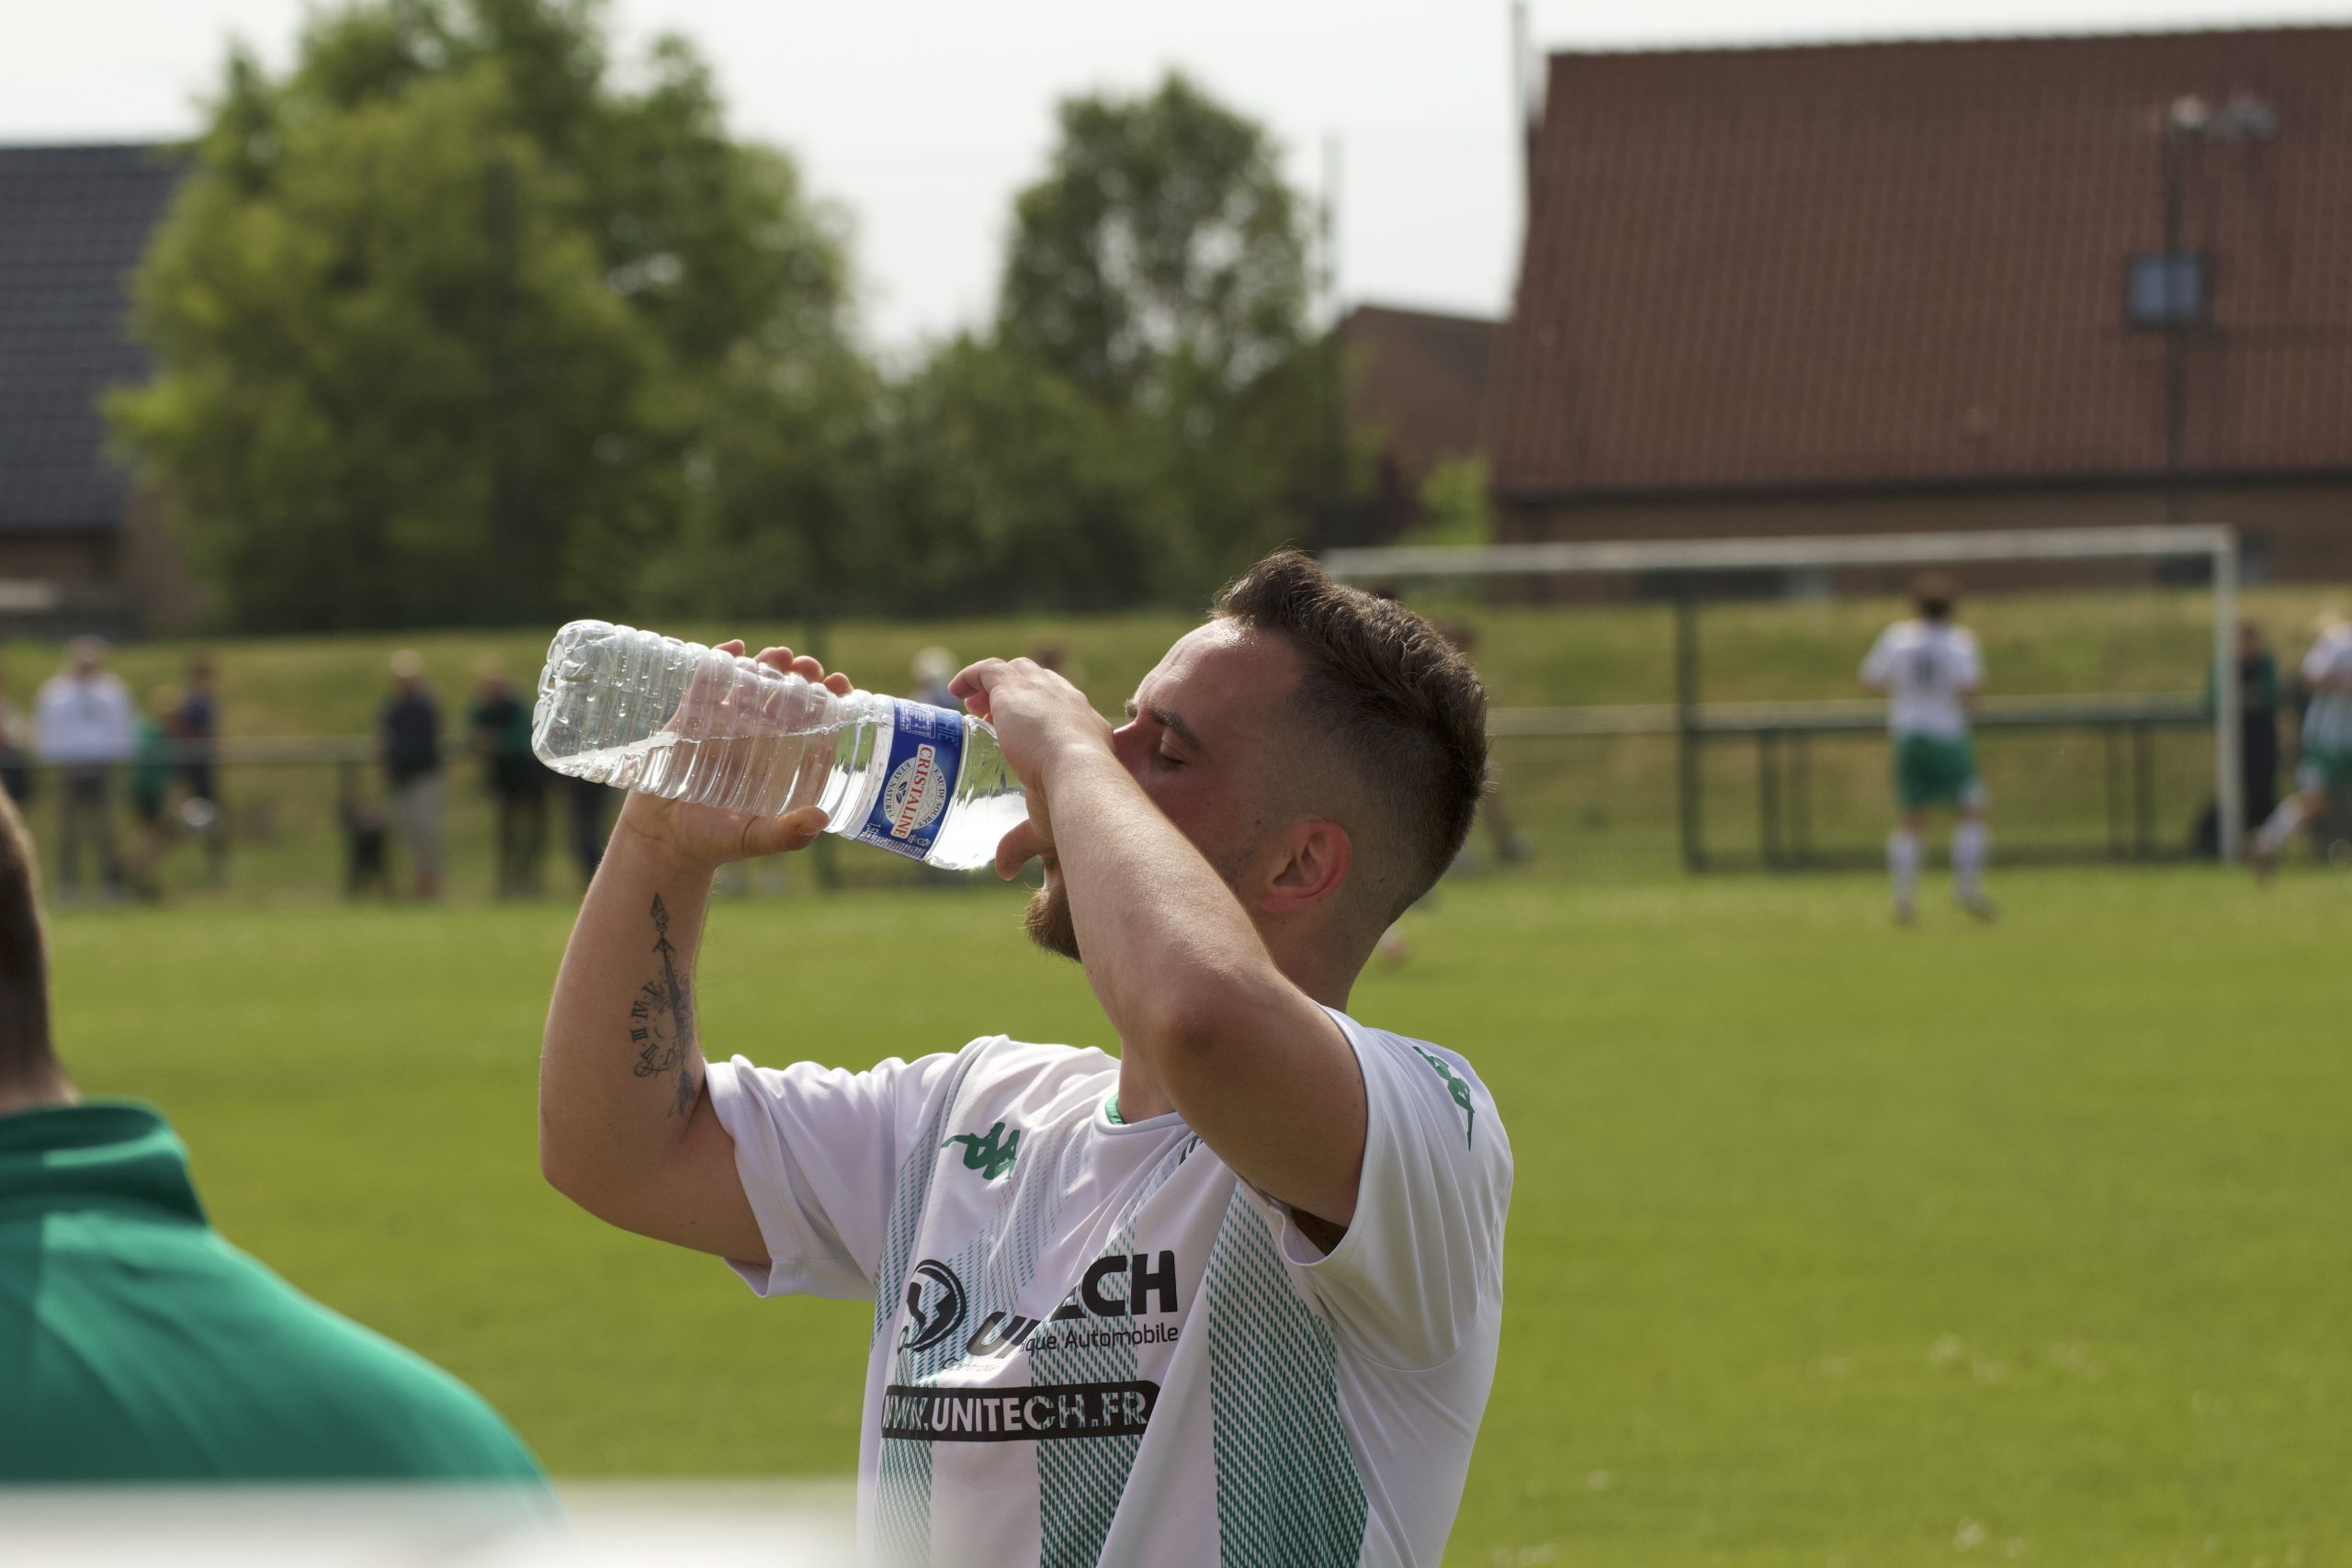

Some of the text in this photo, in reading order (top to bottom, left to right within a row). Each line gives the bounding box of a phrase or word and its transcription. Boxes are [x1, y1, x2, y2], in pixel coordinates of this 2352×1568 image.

[885, 783, 896, 818] NATUREL
[893, 747, 933, 837] CRISTALINE
[917, 769, 945, 828] EAU DE SOURCE
[1064, 1322, 1179, 1349] Automobile
[882, 1391, 1148, 1432] WWW.UNITECH.FR
